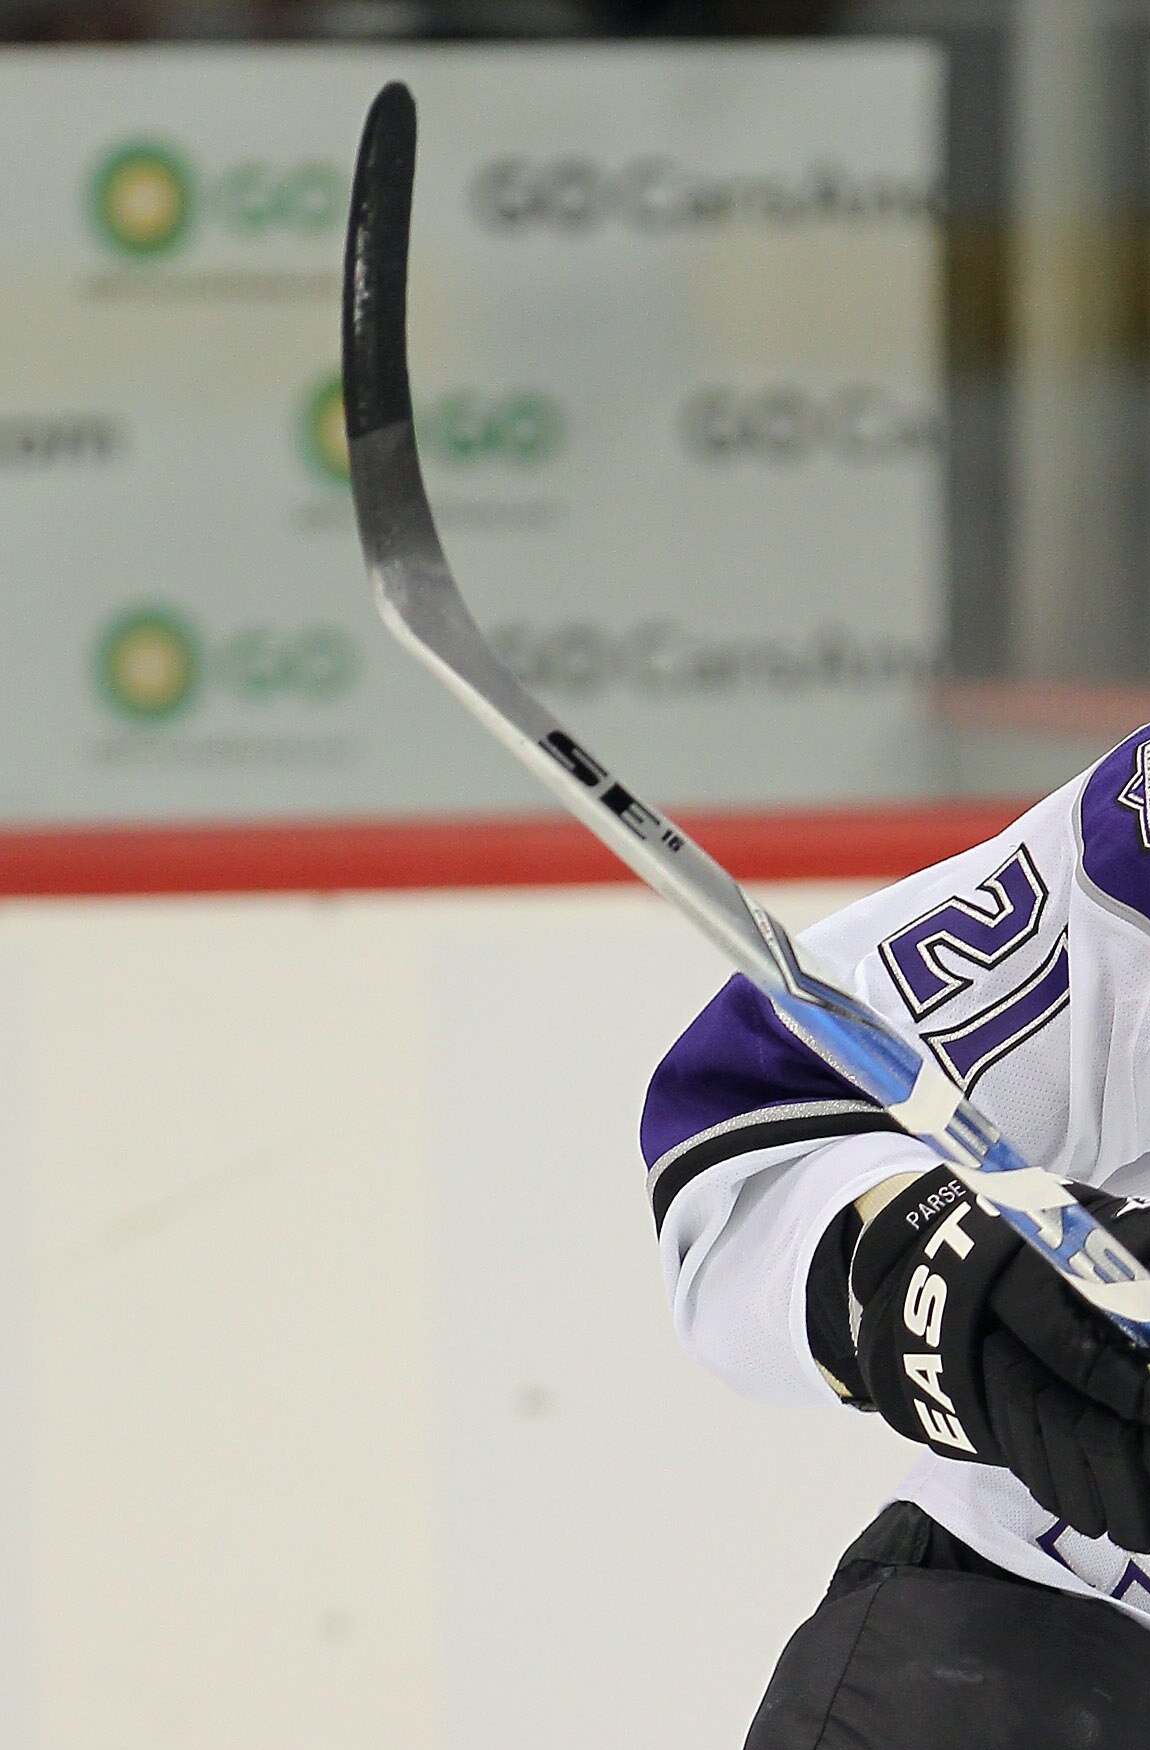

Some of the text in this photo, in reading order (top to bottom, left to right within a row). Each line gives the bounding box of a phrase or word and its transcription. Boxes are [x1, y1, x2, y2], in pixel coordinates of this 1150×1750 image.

[877, 842, 1070, 1100] 21
[903, 1193, 1001, 1455] EAST
[905, 1179, 967, 1231] PARSE
